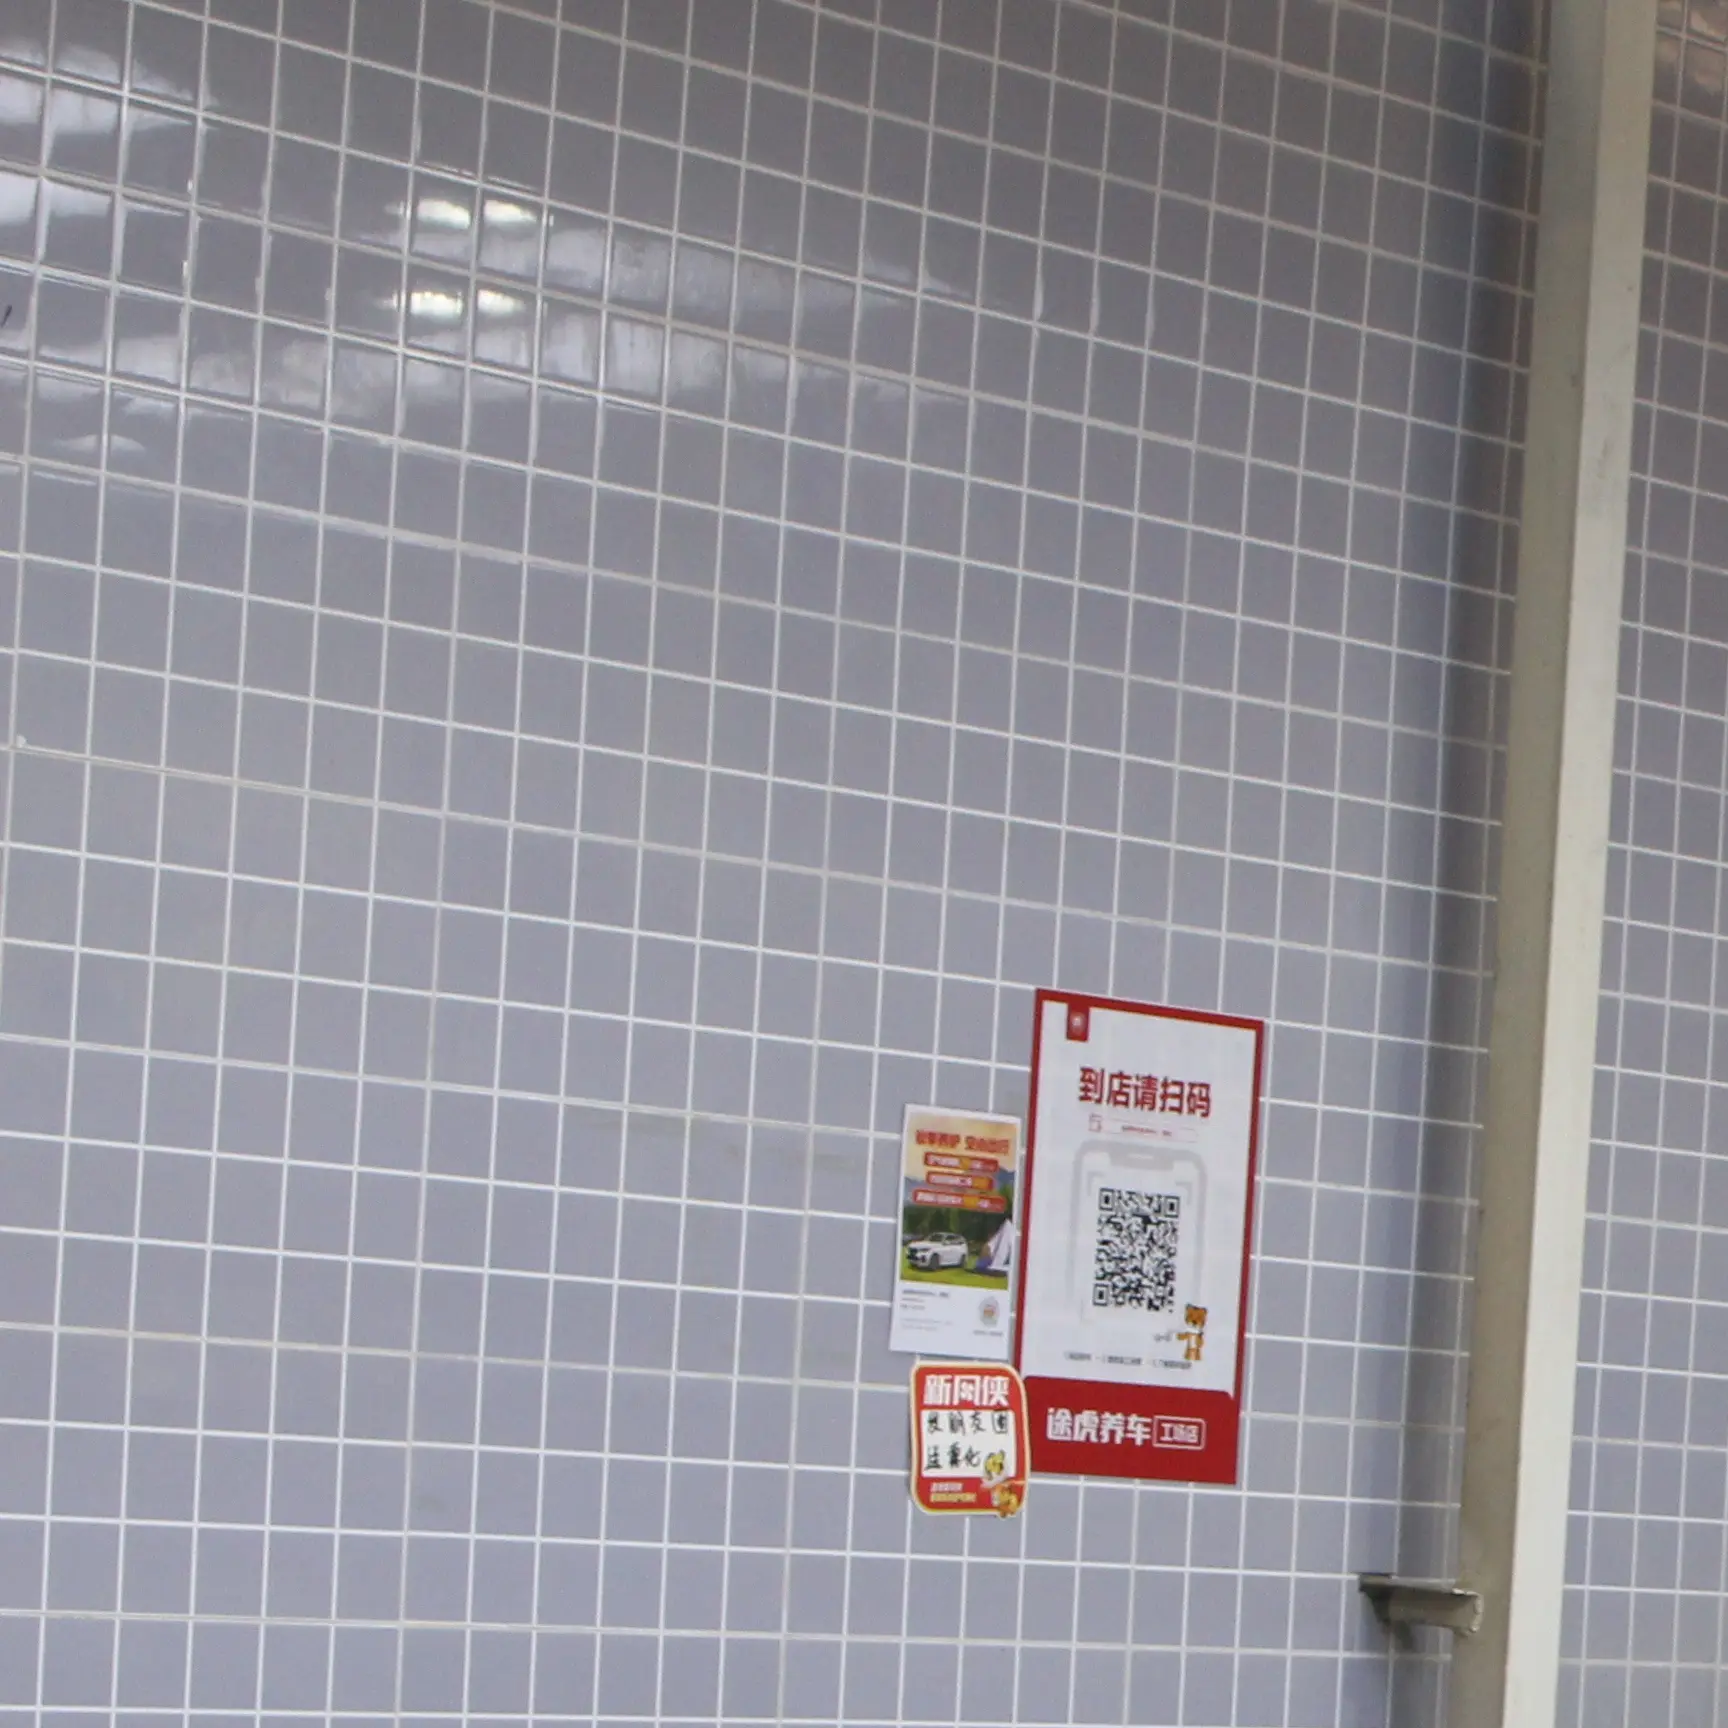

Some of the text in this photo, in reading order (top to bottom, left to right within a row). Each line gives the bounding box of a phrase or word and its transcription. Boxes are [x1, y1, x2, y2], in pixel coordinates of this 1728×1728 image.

[1078, 1066, 1211, 1118] 到店请扫码
[1046, 1407, 1152, 1447] 途虎养车
